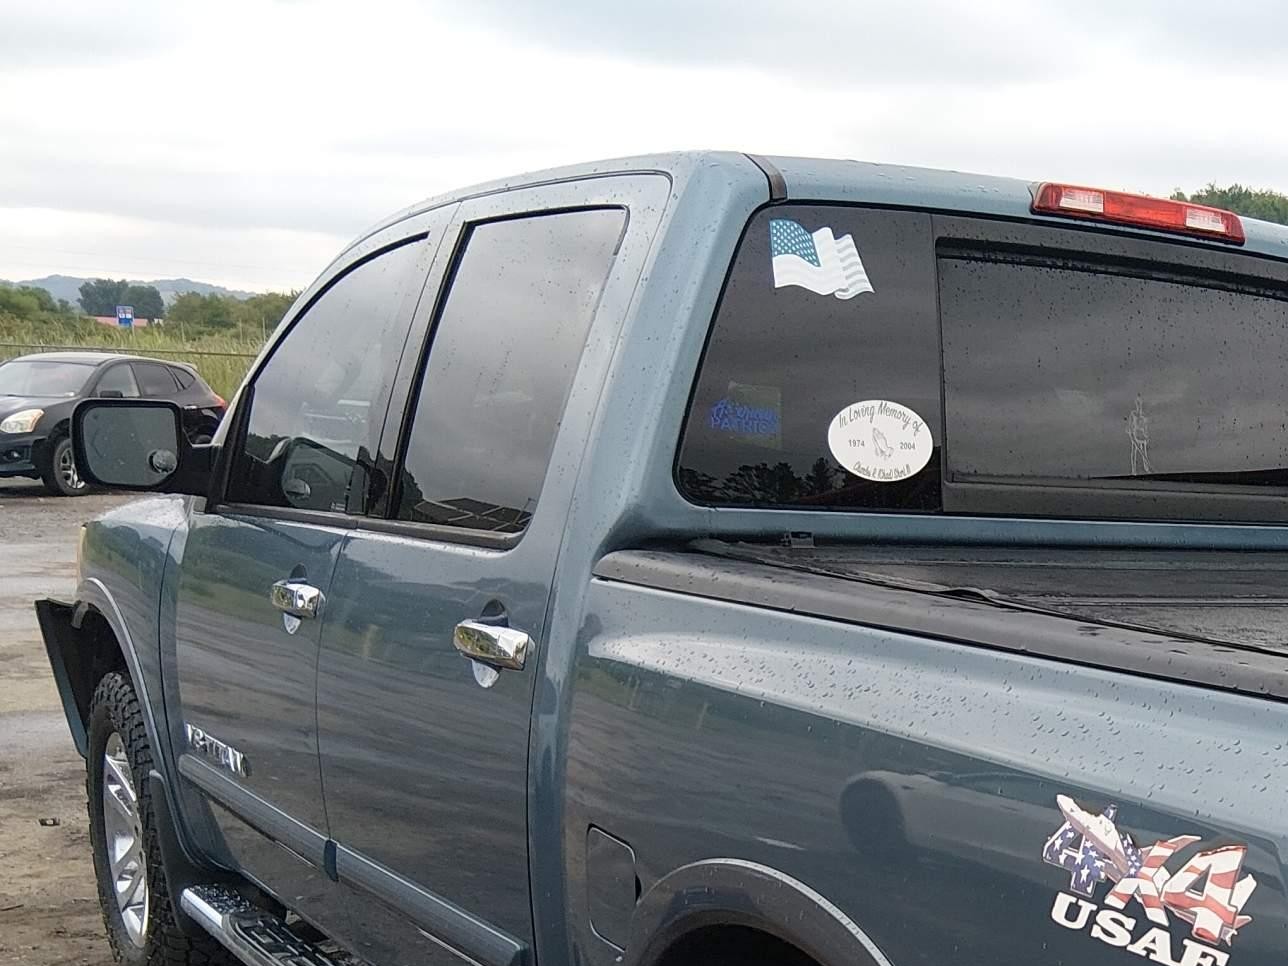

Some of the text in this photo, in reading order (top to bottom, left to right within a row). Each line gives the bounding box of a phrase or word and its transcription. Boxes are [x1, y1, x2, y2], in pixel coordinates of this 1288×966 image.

[838, 401, 923, 436] In Loving Memory of
[848, 439, 865, 447] 1974
[899, 442, 916, 450] 2004
